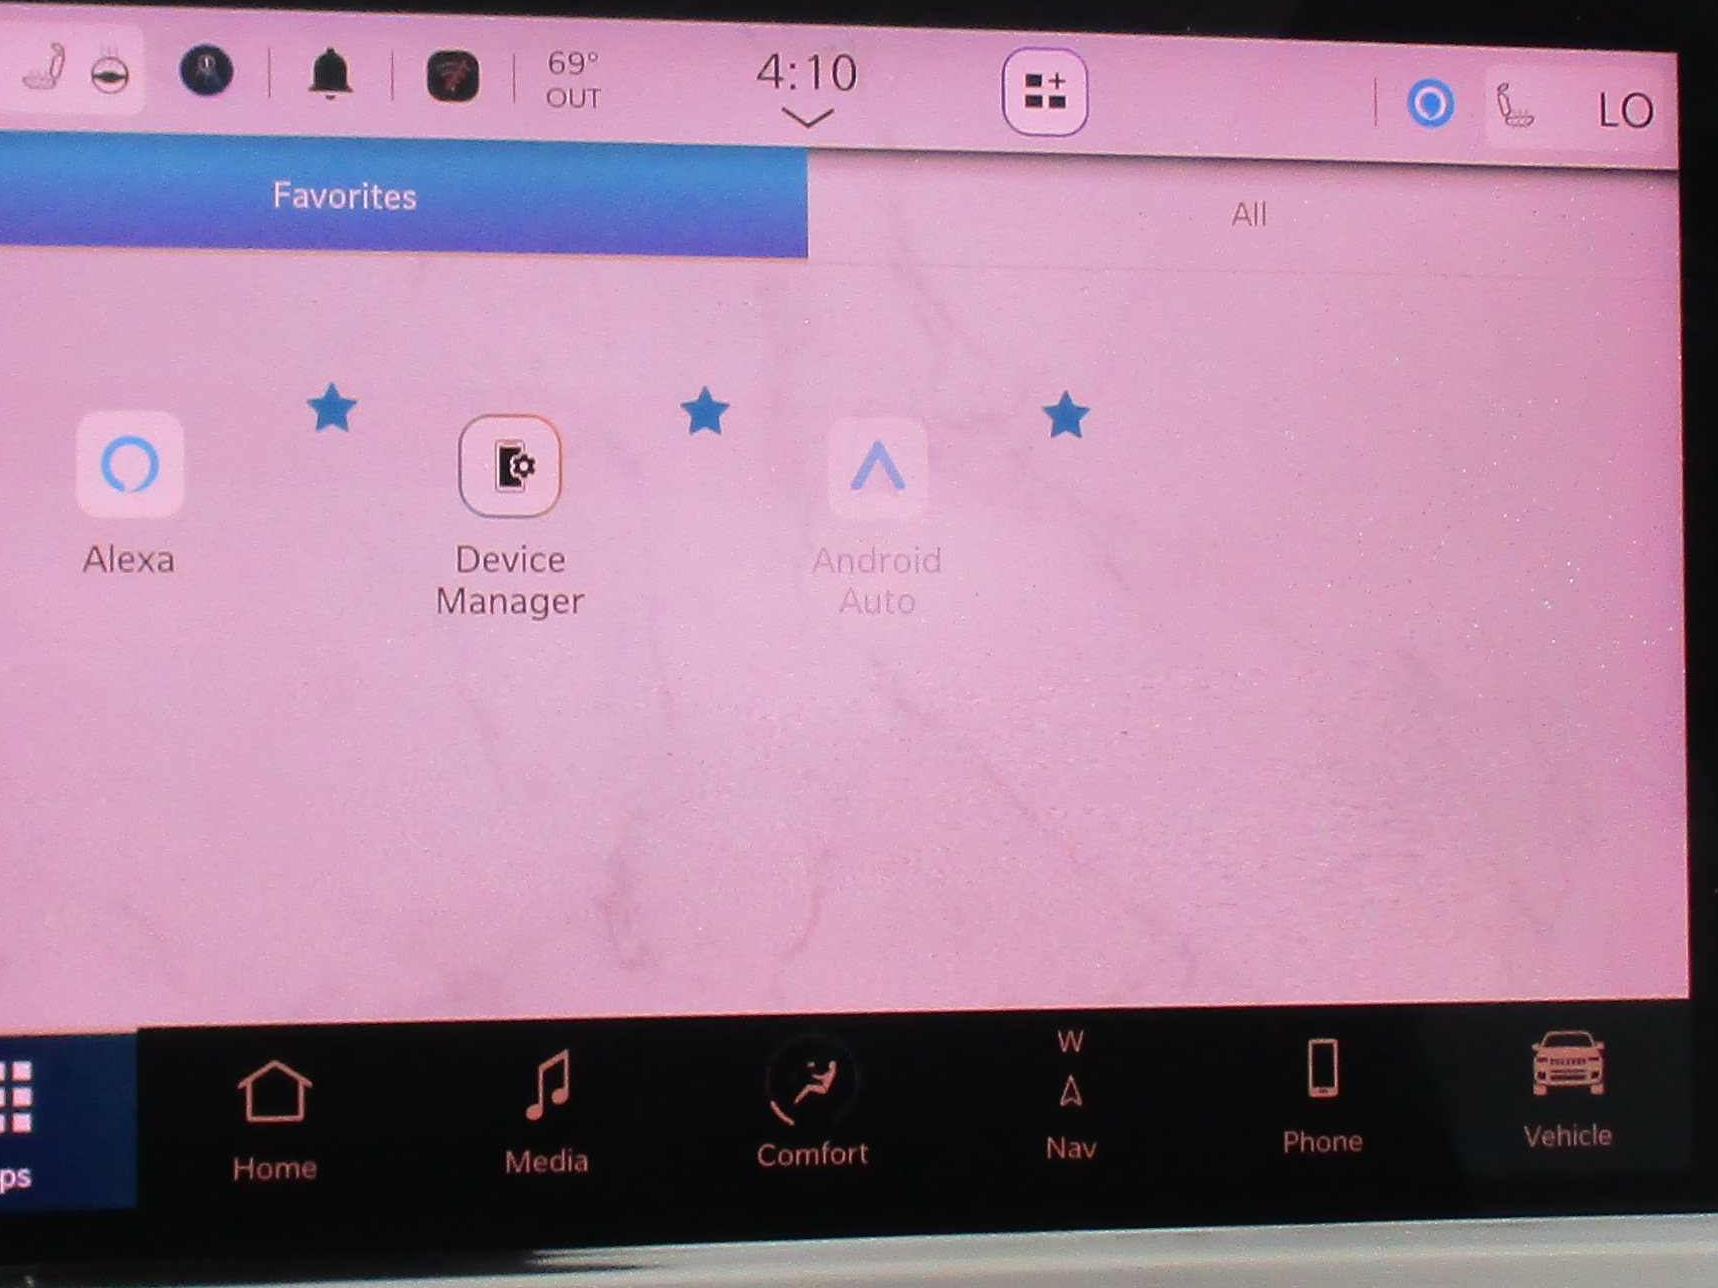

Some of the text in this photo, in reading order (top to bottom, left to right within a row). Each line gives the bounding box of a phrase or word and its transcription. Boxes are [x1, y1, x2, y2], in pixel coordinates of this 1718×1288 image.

[548, 50, 599, 76] 69°
[757, 53, 858, 92] 4:10
[546, 87, 601, 110] OUT
[1599, 92, 1654, 130] LO
[274, 180, 417, 212] Favorites
[1232, 200, 1267, 227] All
[82, 544, 174, 574] Alexa
[456, 545, 565, 574] Device
[812, 546, 941, 574] Android
[437, 585, 584, 624] Manager
[839, 587, 916, 615] Auto
[1057, 1030, 1083, 1053] W
[1046, 1137, 1097, 1160] Nav
[1284, 1130, 1363, 1153] Phone
[1524, 1123, 1612, 1148] Vehicle
[505, 1148, 589, 1173] Media
[758, 1141, 868, 1166] Comfort
[233, 1157, 317, 1181] Home
